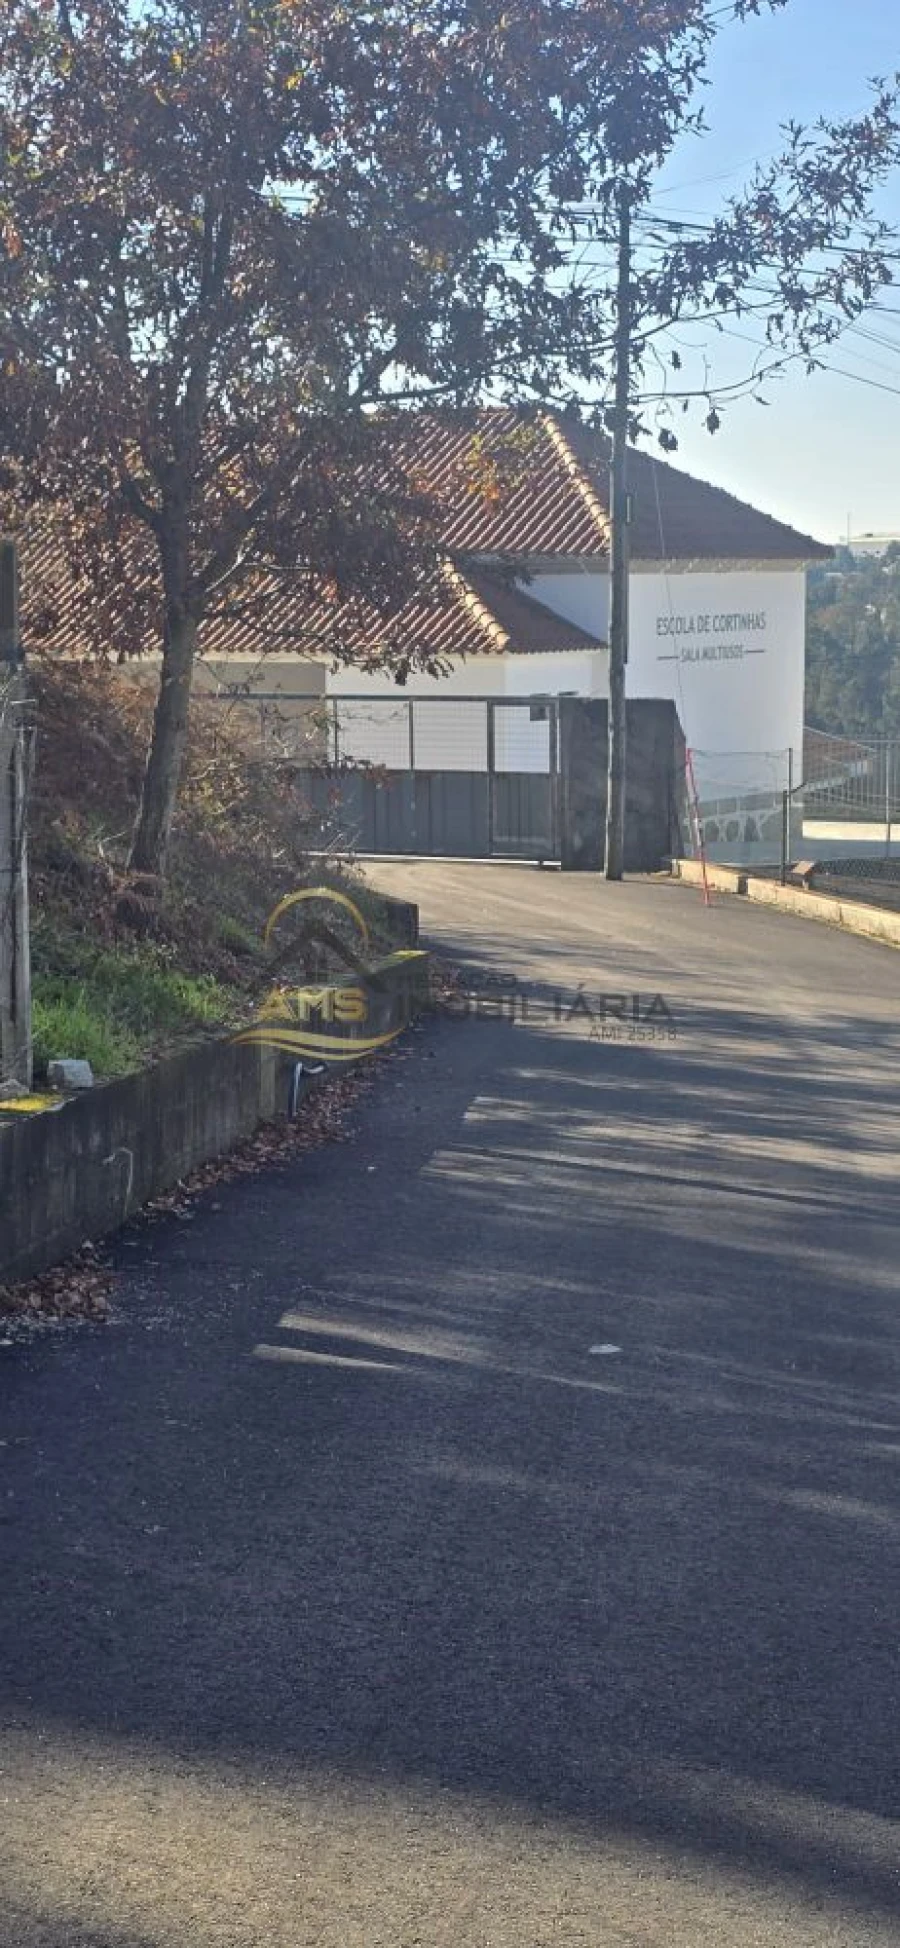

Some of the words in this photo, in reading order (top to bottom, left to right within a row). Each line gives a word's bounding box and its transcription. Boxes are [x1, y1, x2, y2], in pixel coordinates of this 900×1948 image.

[657, 615, 695, 636] ESCOLA
[697, 614, 710, 633] DE
[712, 611, 766, 632] CORTINHAS
[681, 646, 700, 662] SALA
[702, 644, 743, 661] MULTIUSOS
